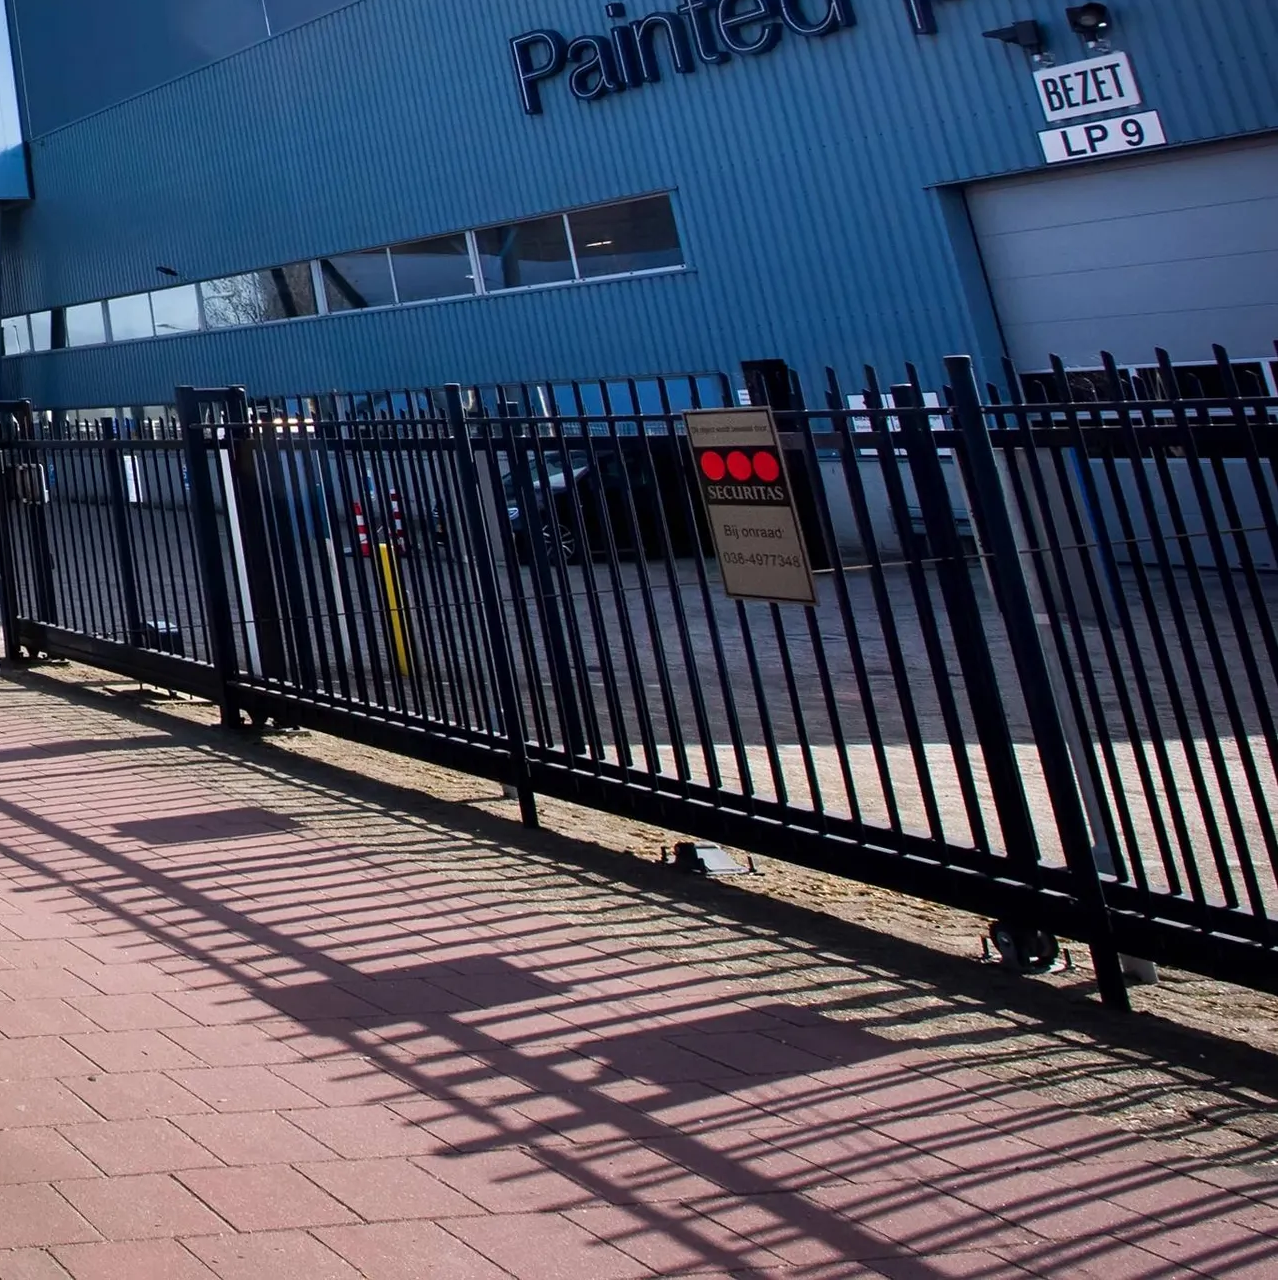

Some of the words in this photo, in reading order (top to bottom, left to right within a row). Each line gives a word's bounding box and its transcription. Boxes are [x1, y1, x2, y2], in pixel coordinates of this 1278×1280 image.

[1041, 62, 1124, 112] BEZET
[1059, 122, 1109, 158] LP
[1120, 117, 1146, 147] 9
[707, 485, 784, 501] SECURITAS
[723, 524, 740, 539] Bij
